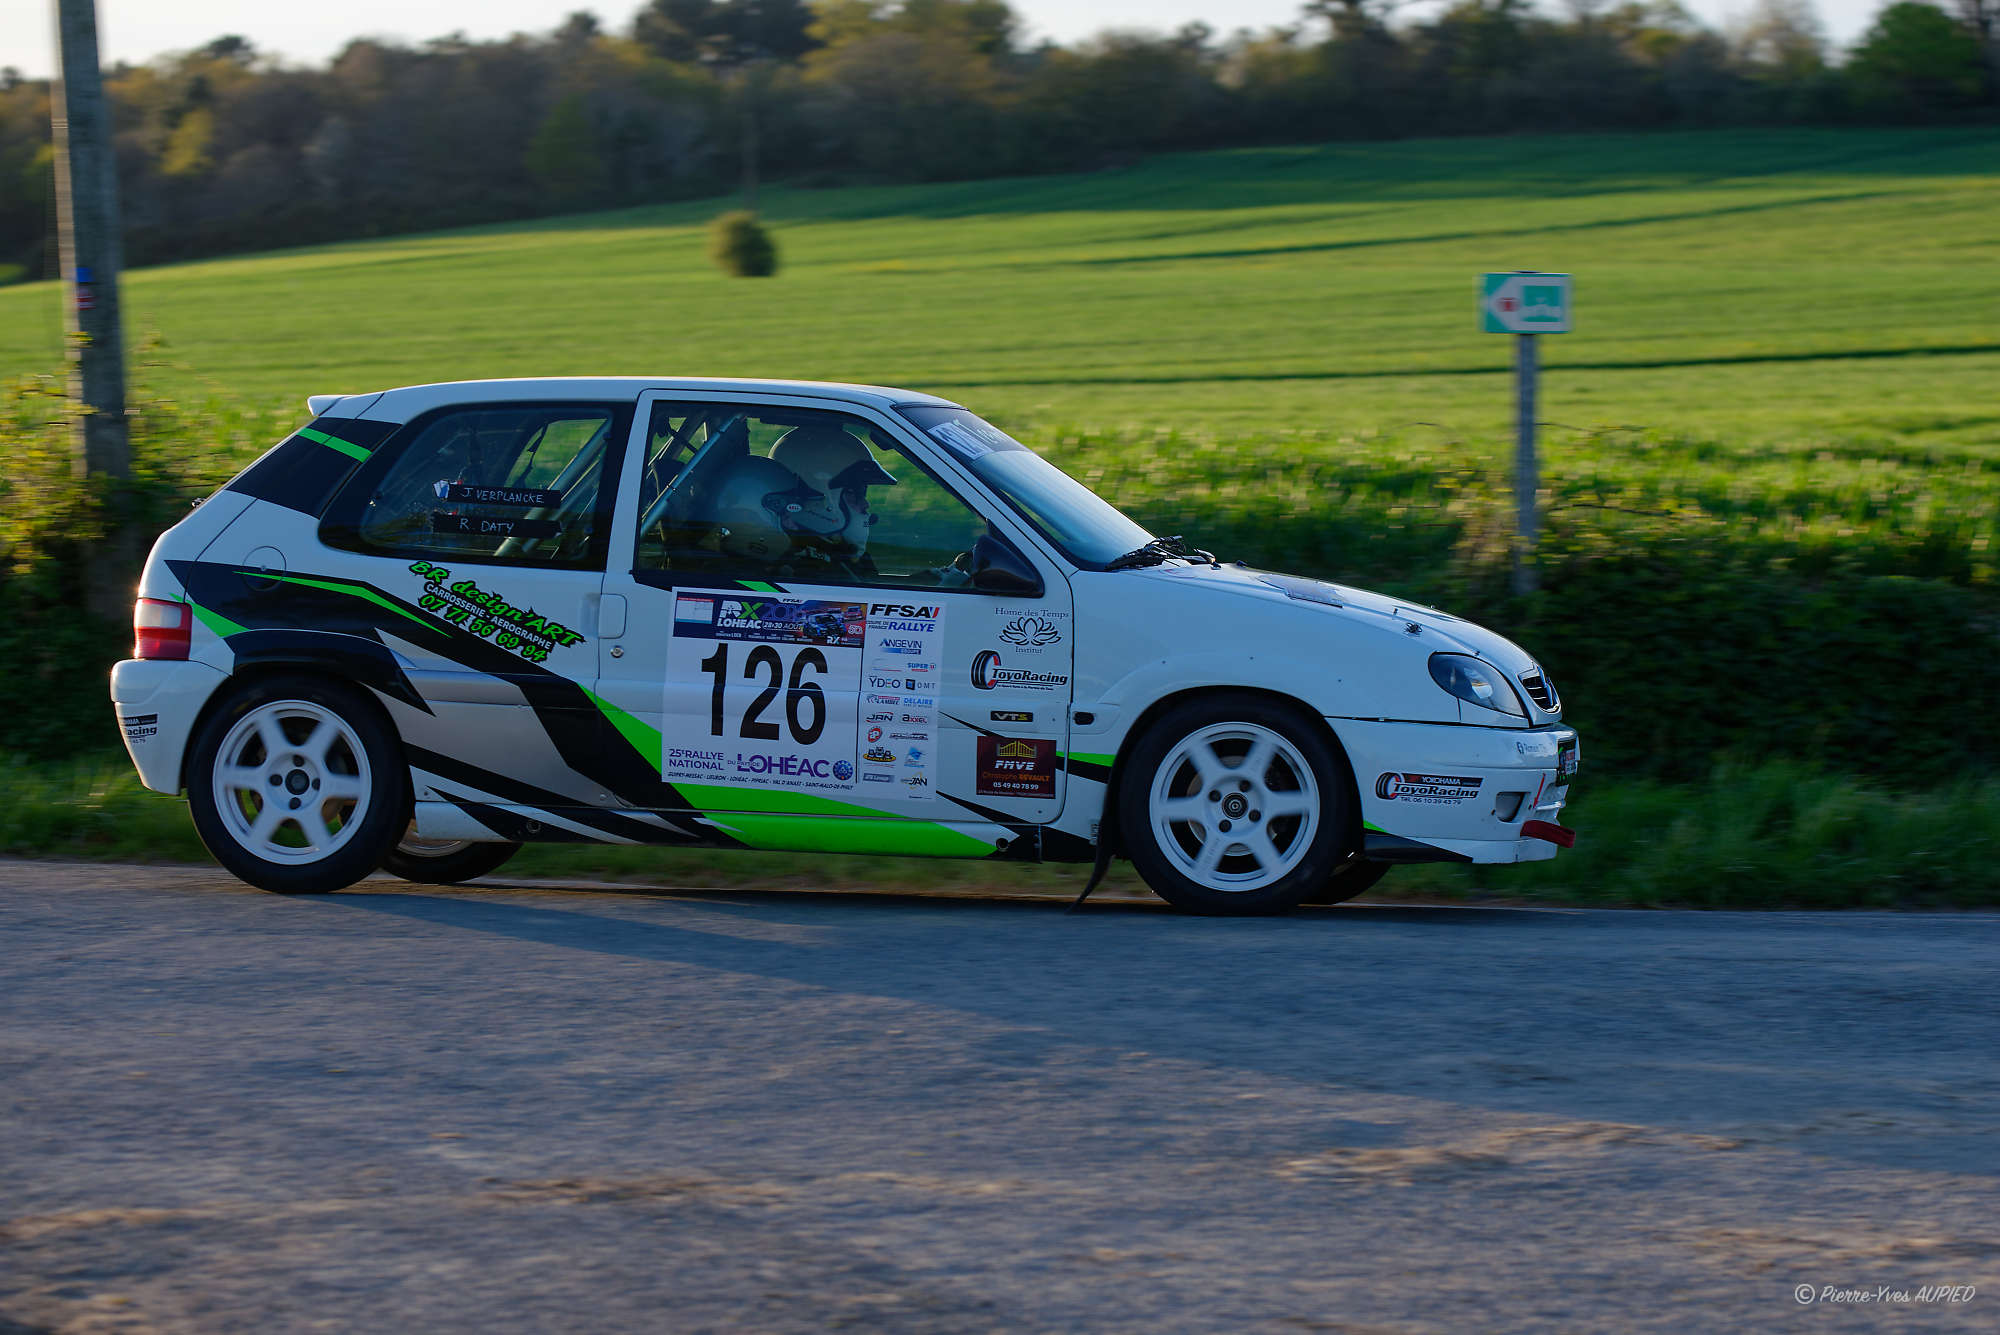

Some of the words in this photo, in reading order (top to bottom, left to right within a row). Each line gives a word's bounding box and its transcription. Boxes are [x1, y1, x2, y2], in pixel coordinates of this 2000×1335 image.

[476, 489, 545, 504] VERPLANCKE
[481, 520, 515, 534] DATY
[410, 561, 449, 583] BR
[451, 580, 586, 647] design'ART
[719, 600, 764, 621] RX
[869, 603, 933, 619] FFSA
[427, 583, 485, 619] CARROSSERIE
[491, 616, 552, 650] AEROGRAPHE
[995, 607, 1022, 615] Home
[1024, 608, 1039, 617] des
[1040, 608, 1069, 619] Temps
[419, 594, 447, 611] 07
[446, 606, 471, 623] 71
[470, 617, 496, 637] 56
[496, 631, 521, 649] 69
[522, 644, 548, 662] 94
[716, 618, 763, 629] LOHEAC
[887, 621, 936, 633] RALLYE
[880, 638, 922, 649] ANGEVIN
[992, 668, 1069, 686] ToyoRacing
[701, 643, 828, 745] 126
[994, 712, 1029, 721] VTS
[685, 749, 725, 761] RALLYE
[669, 758, 725, 771] NATIONAL
[737, 753, 830, 778] LOHÉAC
[1422, 776, 1461, 785] YOKOHAMA
[1394, 783, 1479, 799] ToyoRacing
